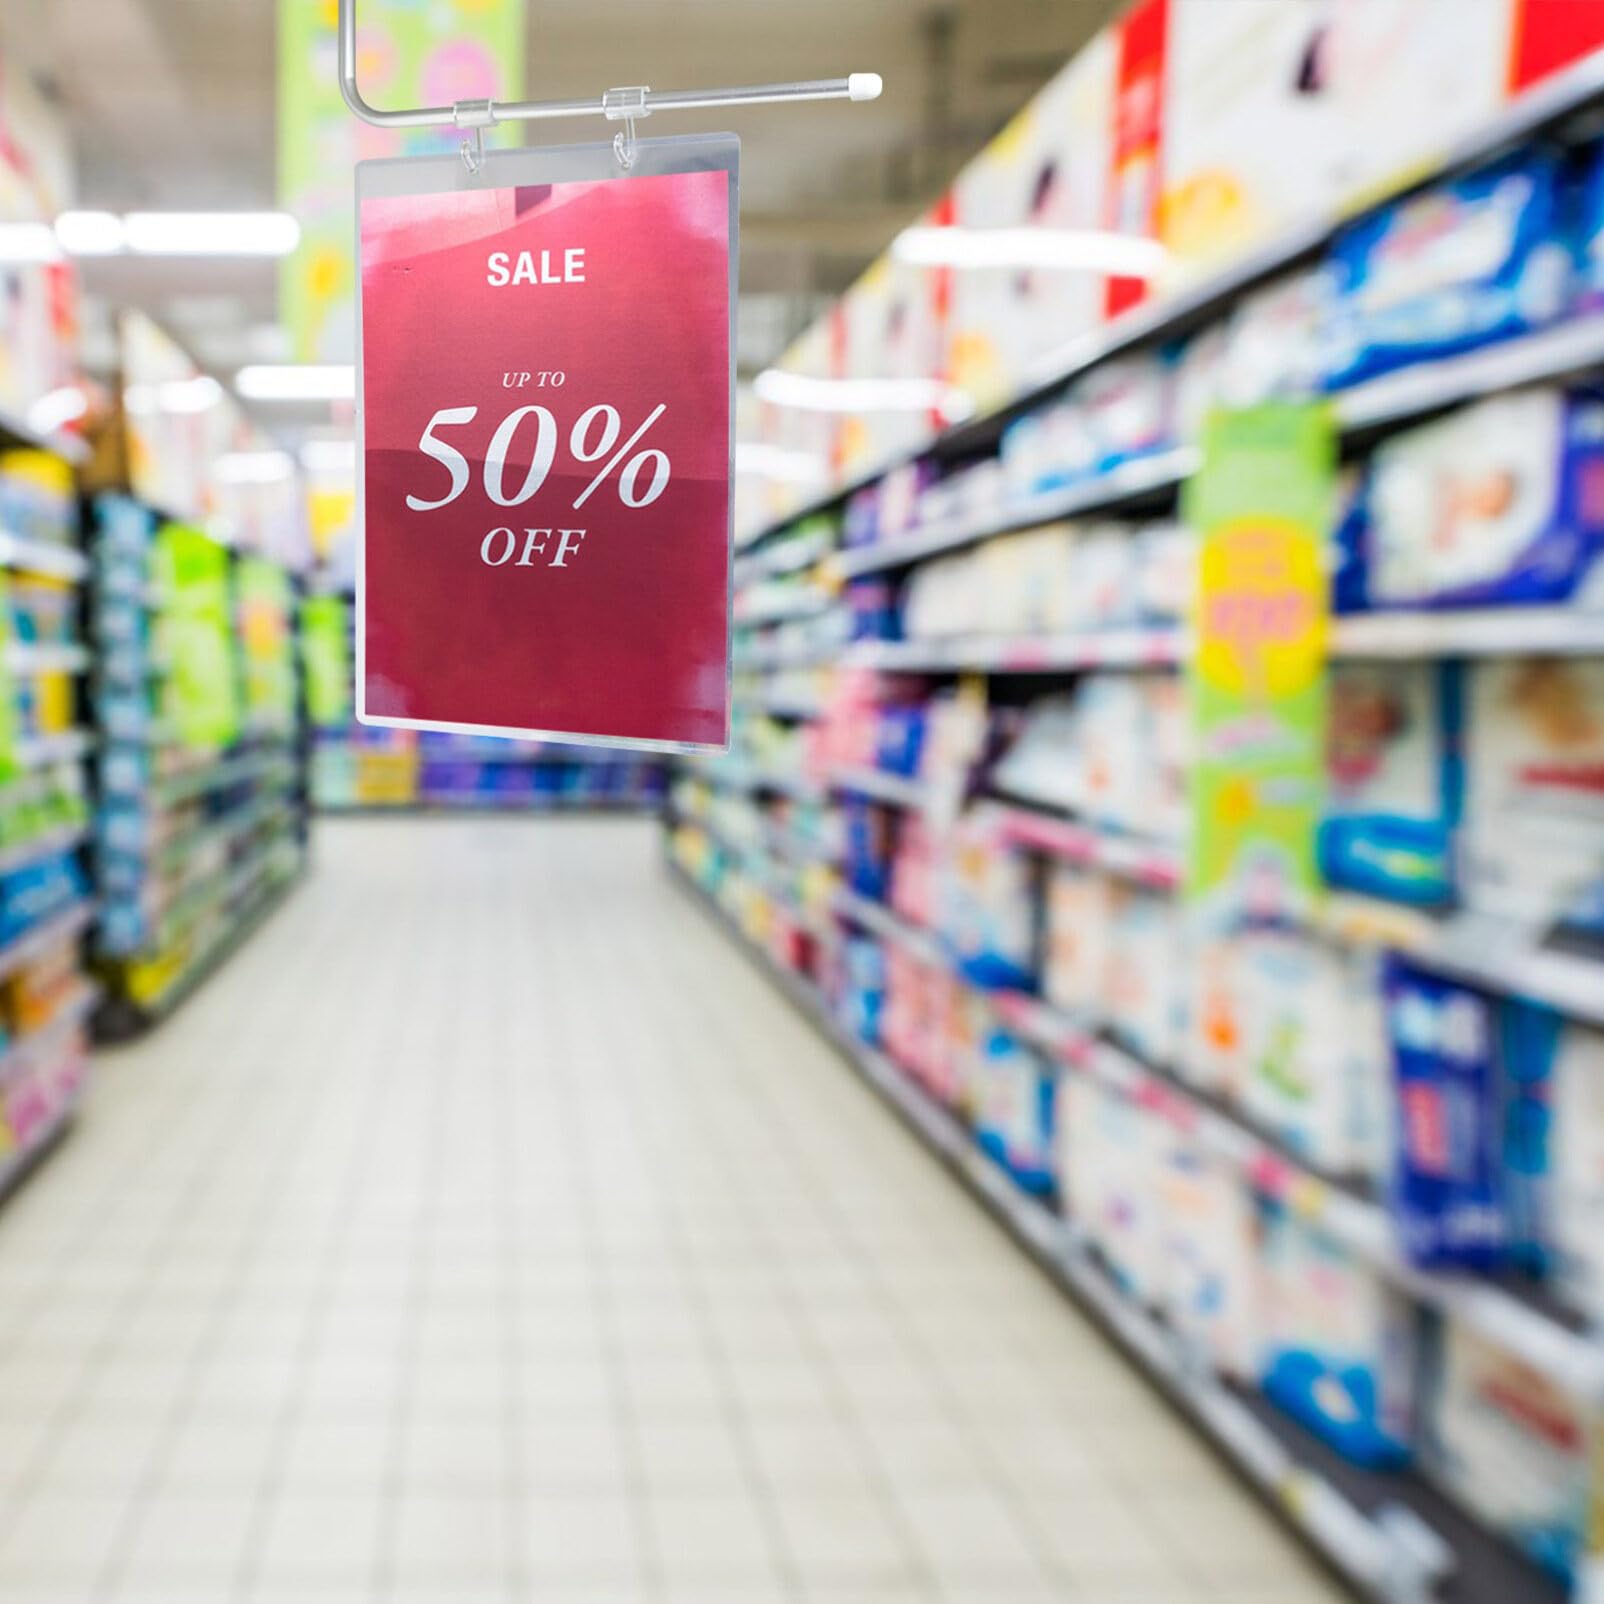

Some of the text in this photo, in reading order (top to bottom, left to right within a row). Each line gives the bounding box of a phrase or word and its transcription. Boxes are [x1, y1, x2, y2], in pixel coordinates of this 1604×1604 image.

[487, 248, 586, 287] SALE
[502, 371, 567, 388] UP TO
[405, 403, 671, 511] 50%
[480, 527, 587, 568] OFF
